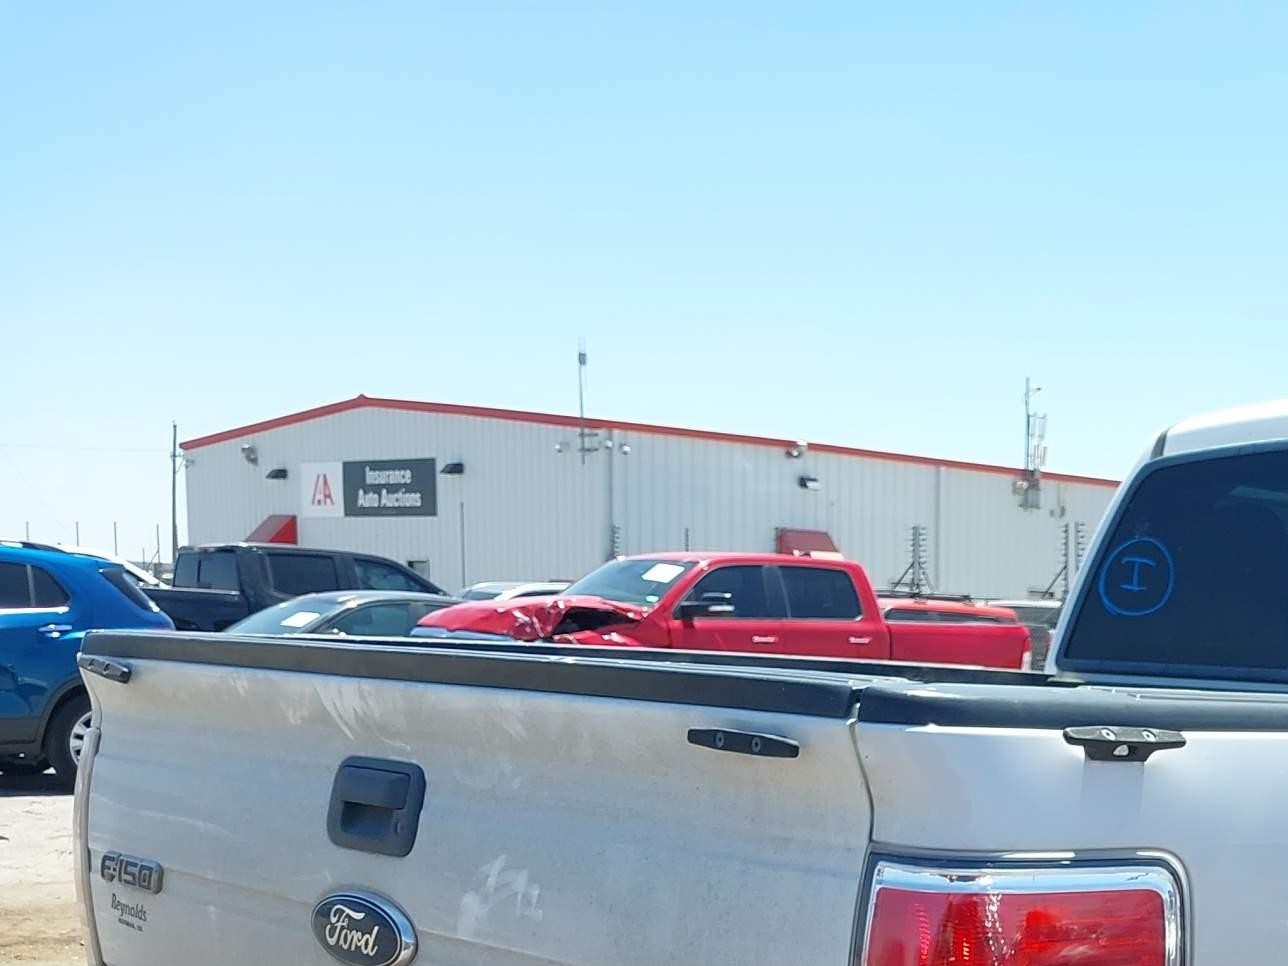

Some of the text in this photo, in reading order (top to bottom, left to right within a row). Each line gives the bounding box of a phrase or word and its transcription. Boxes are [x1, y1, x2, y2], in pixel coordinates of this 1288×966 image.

[365, 465, 412, 485] Insurance
[357, 488, 422, 507] Auto Auctions
[111, 892, 147, 921] Reynolds
[325, 904, 379, 956] Ford
